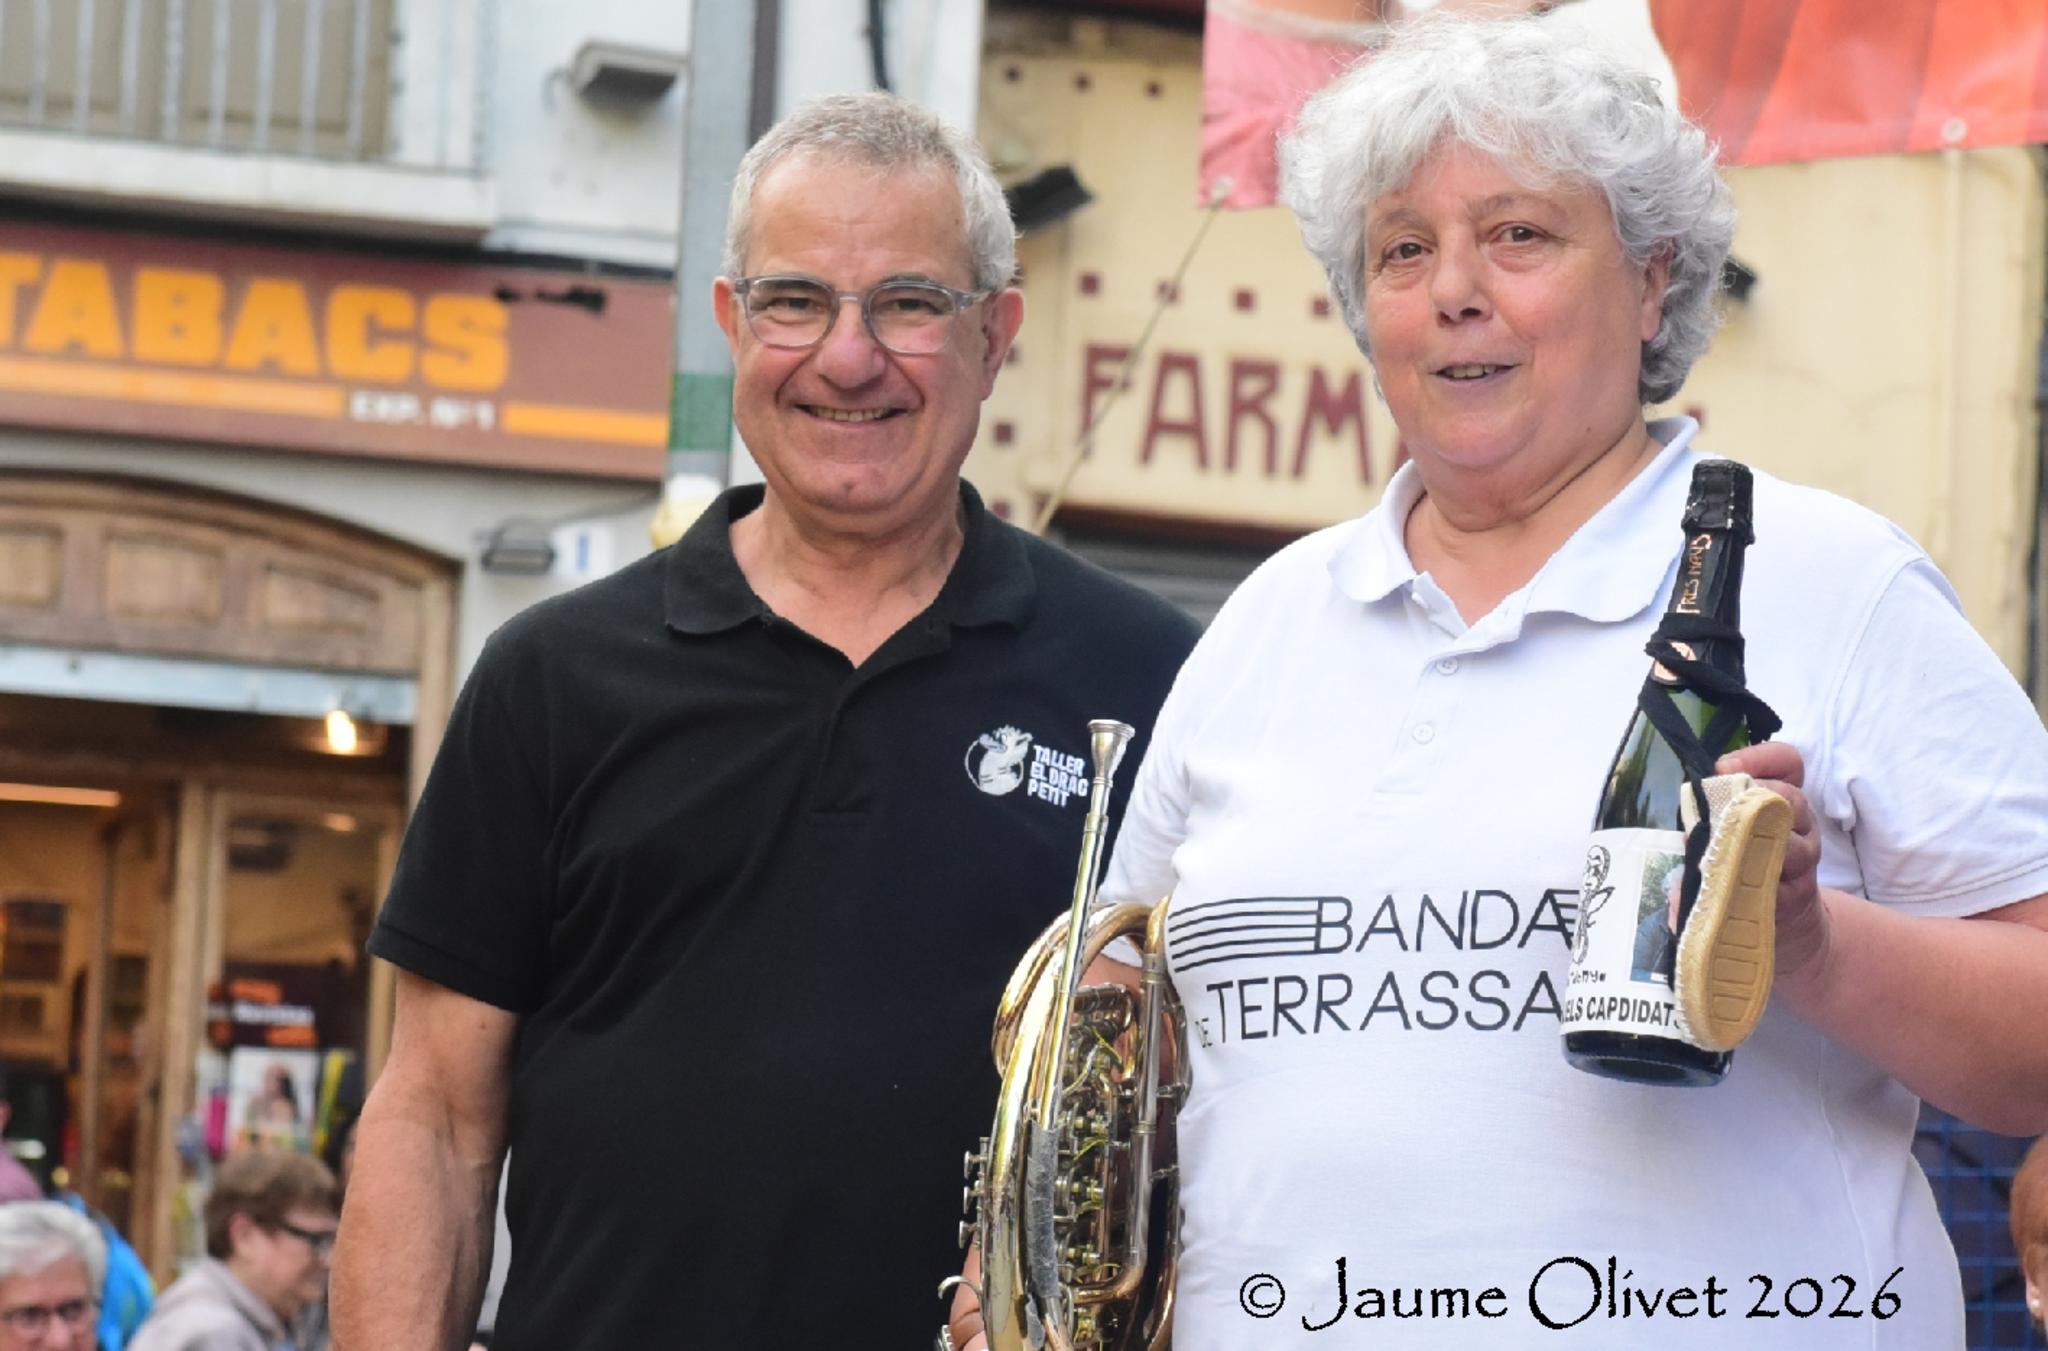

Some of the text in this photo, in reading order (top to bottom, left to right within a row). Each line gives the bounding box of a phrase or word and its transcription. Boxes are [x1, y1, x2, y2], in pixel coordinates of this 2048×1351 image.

[0, 251, 511, 391] TABACS
[1078, 342, 1412, 488] FARM
[1030, 761, 1048, 782] EL
[1033, 745, 1086, 777] TALLER
[1027, 778, 1070, 807] PETIT
[1206, 970, 1563, 1044] TERRASSA
